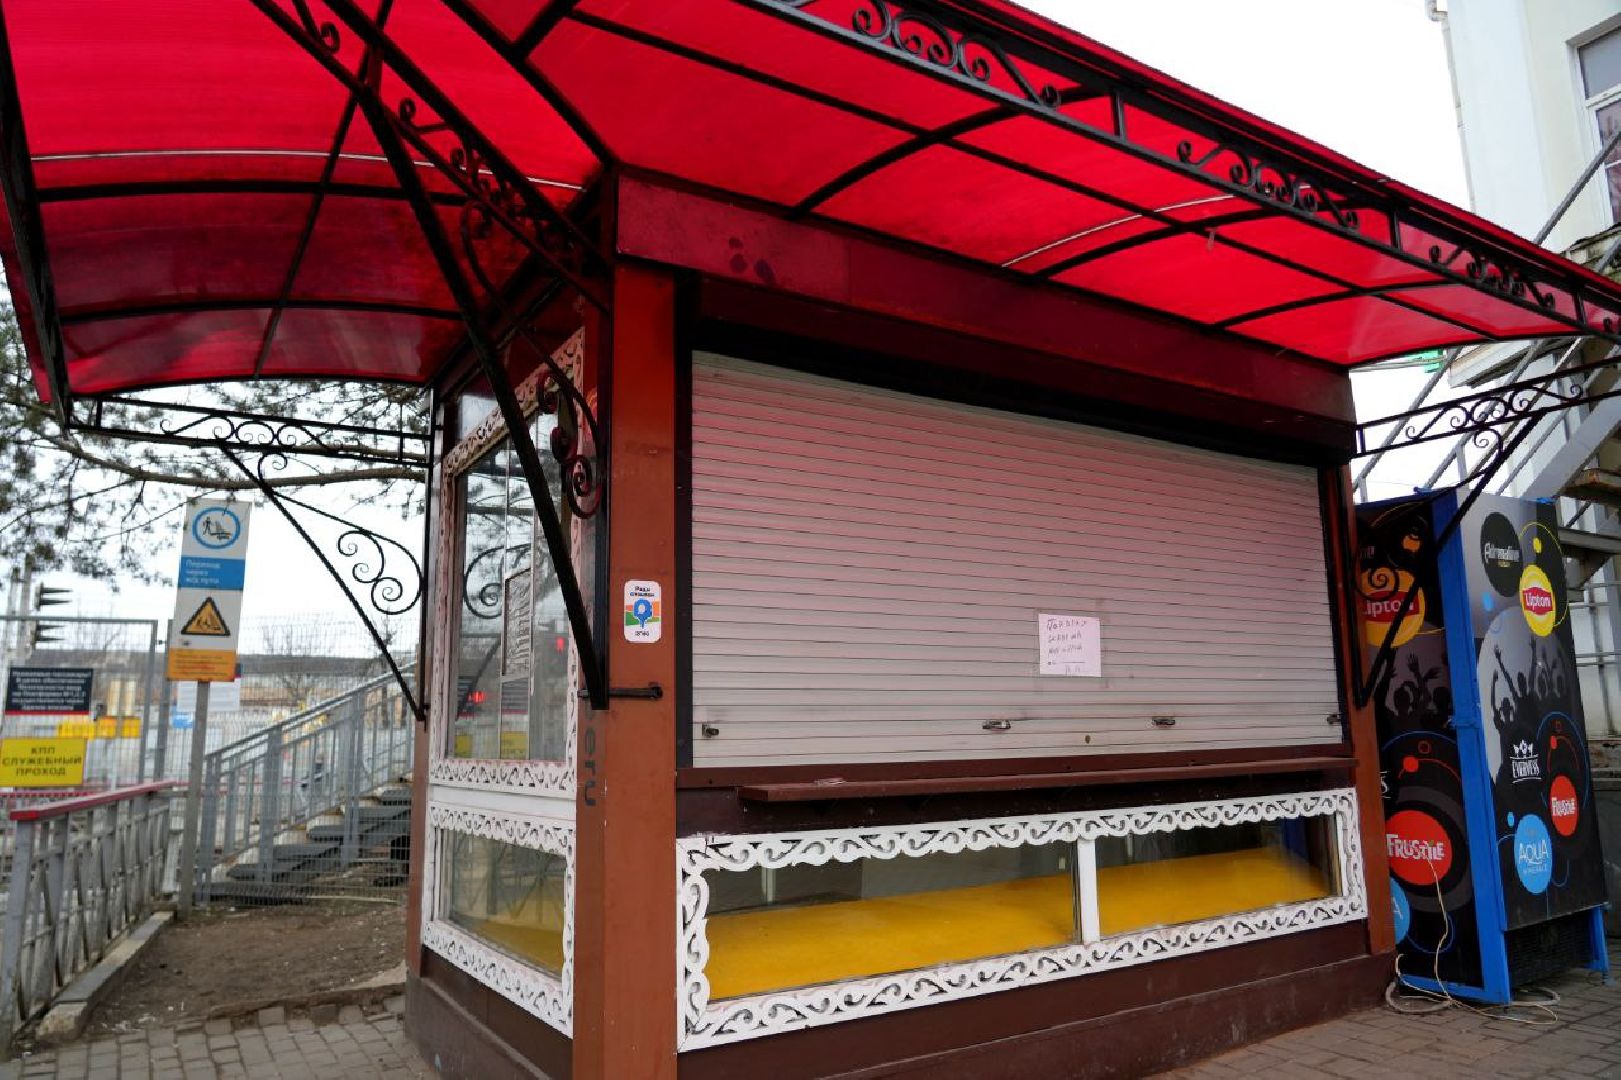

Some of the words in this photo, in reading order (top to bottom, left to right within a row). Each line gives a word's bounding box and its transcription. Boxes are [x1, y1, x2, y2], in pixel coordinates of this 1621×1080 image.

[1525, 592, 1552, 611] Lipton
[31, 746, 56, 755] КПП
[2, 757, 82, 767] СЛУЖЕБНЫЙ
[16, 767, 66, 776] ПРОХОД
[1518, 839, 1549, 864] AQUA
